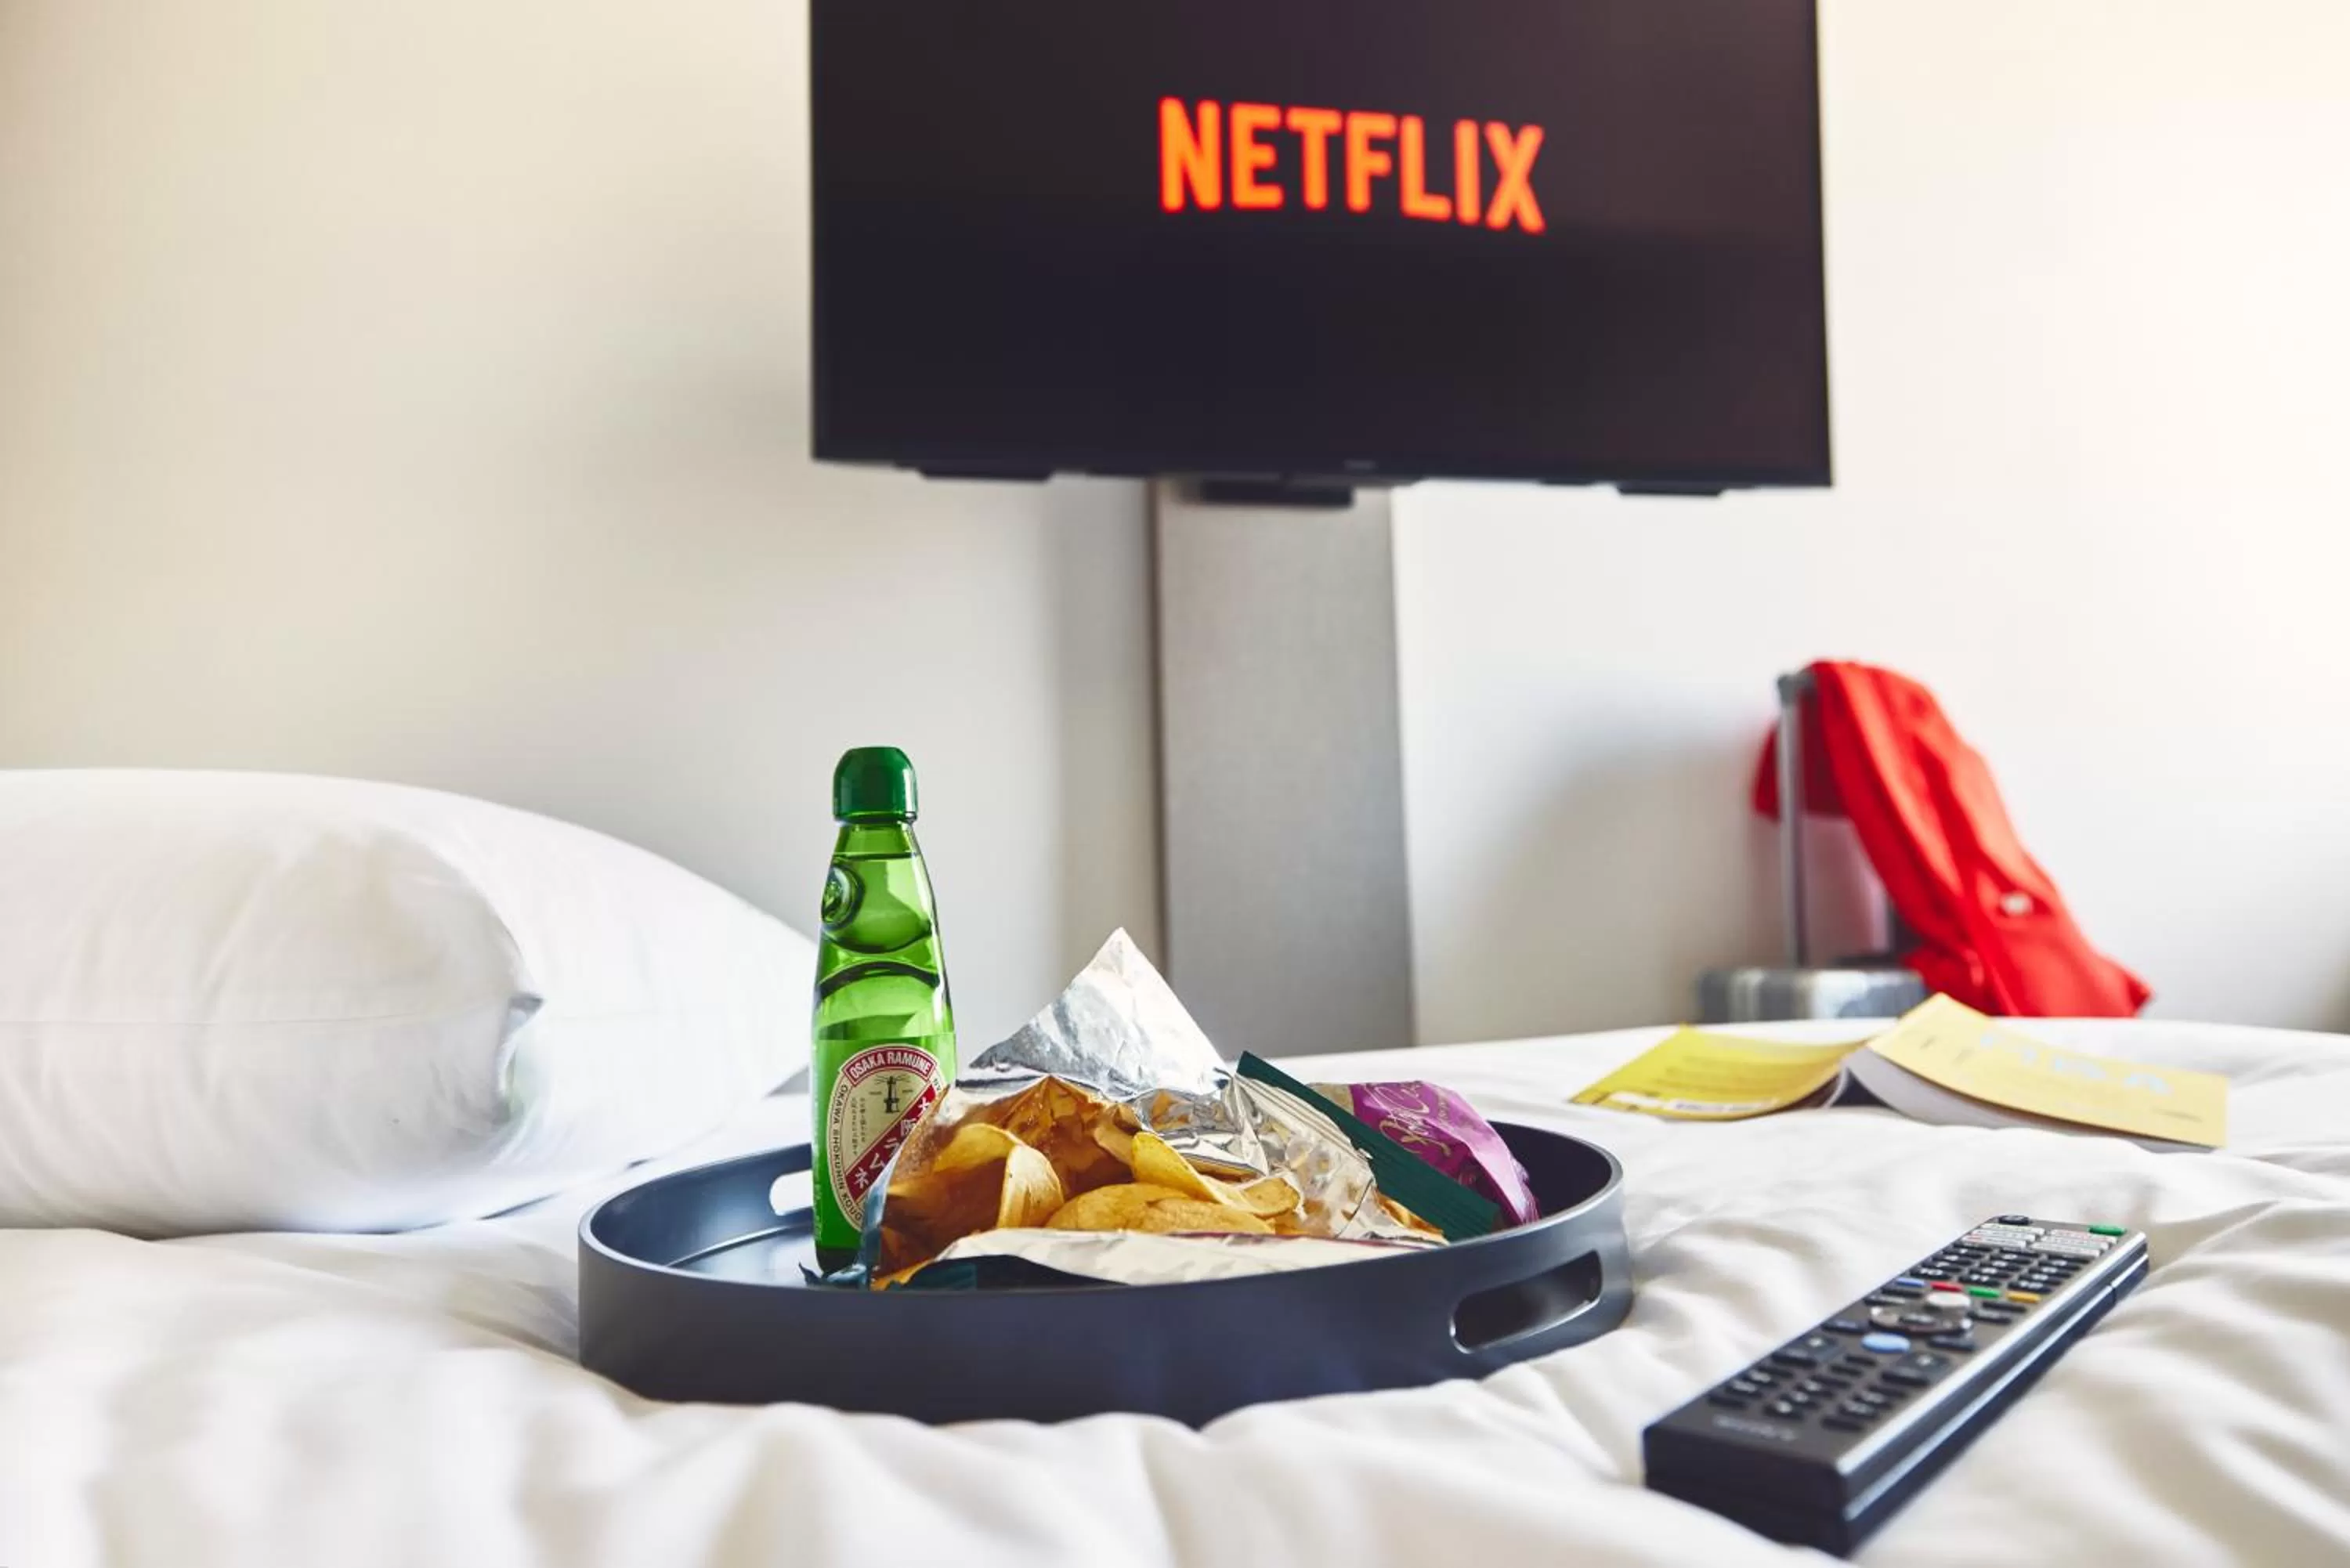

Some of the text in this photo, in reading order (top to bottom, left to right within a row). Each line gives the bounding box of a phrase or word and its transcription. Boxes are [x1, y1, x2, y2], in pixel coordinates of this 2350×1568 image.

[1159, 97, 1546, 233] NETFLIX
[849, 1051, 931, 1078] OSAKA RAMUNE
[833, 1084, 848, 1124] OKAWA
